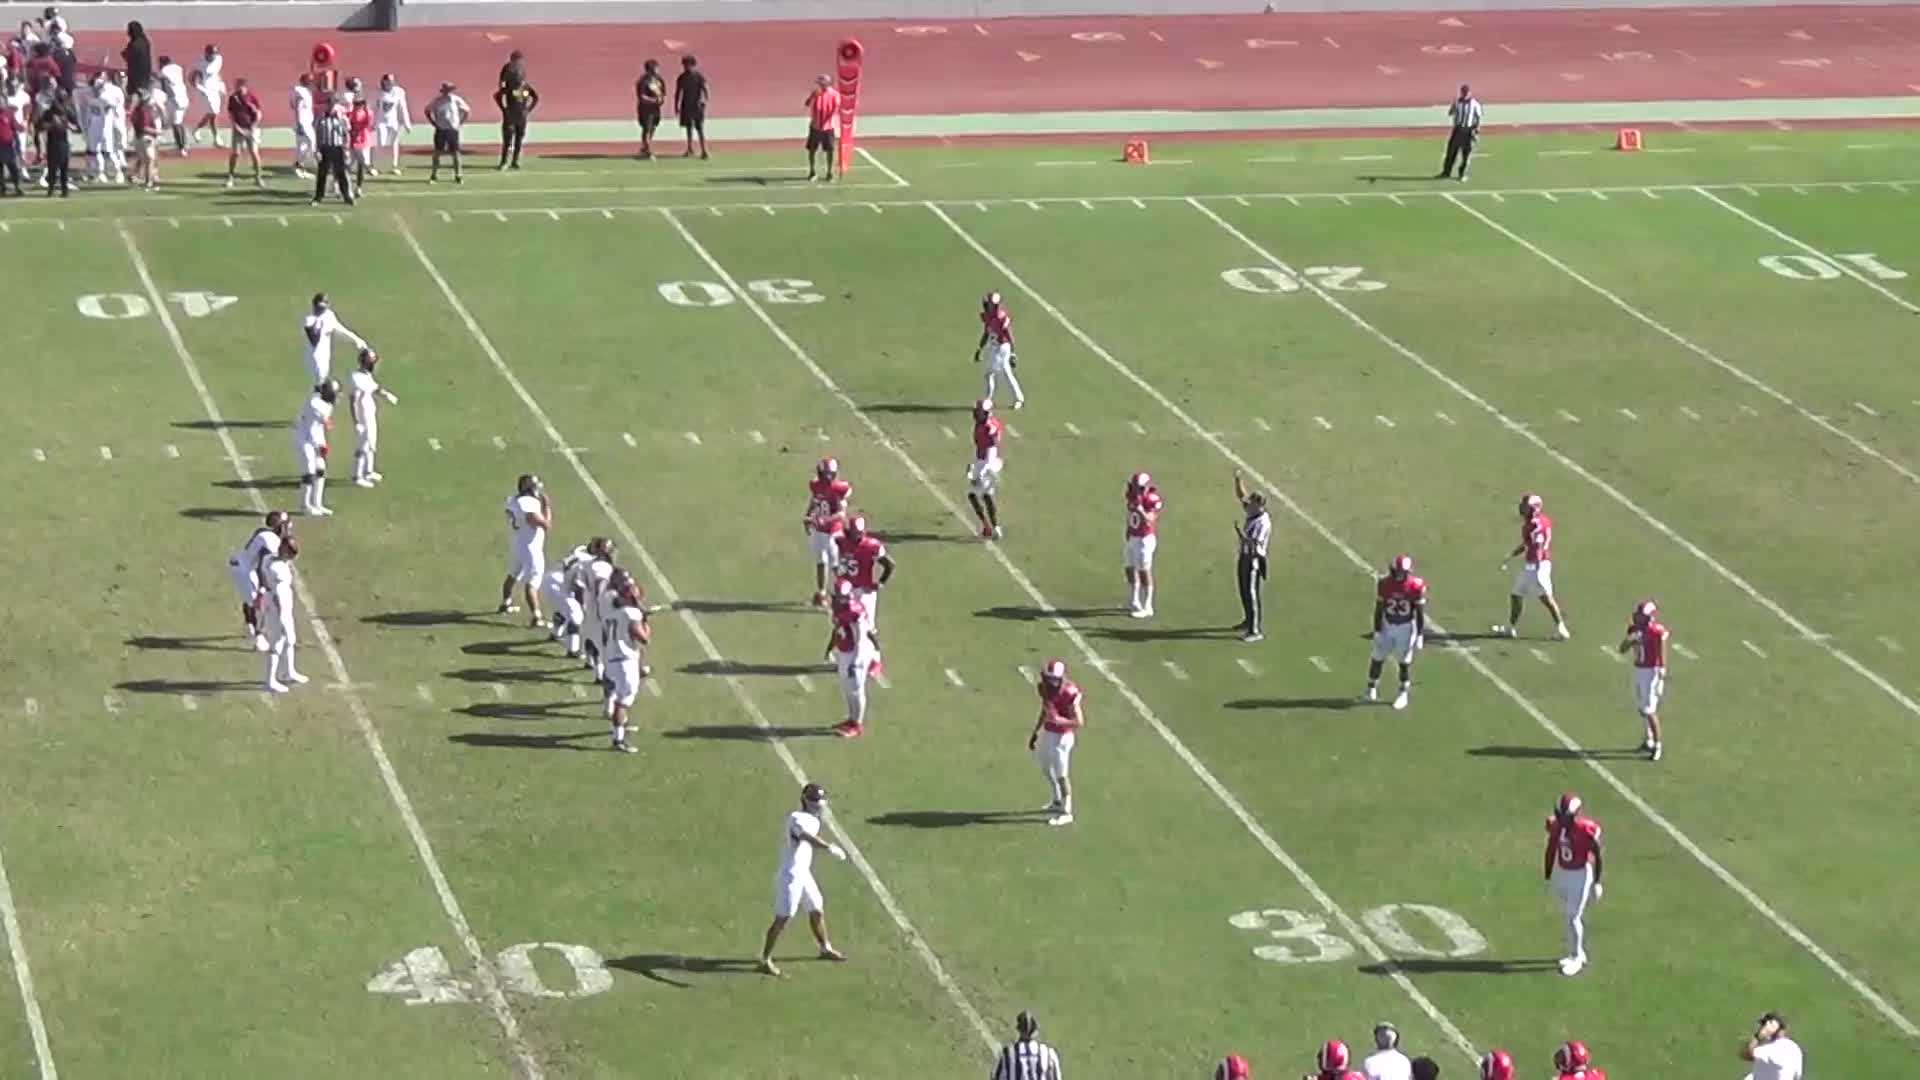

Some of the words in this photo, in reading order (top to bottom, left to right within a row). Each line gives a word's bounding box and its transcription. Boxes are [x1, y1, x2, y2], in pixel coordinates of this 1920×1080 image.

[1220, 265, 1388, 293] 20
[1757, 252, 1908, 280] 10
[76, 292, 239, 319] 40
[657, 278, 827, 306] 30
[1386, 599, 1411, 617] 23
[1228, 903, 1488, 962] 30
[367, 942, 614, 1005] 40
